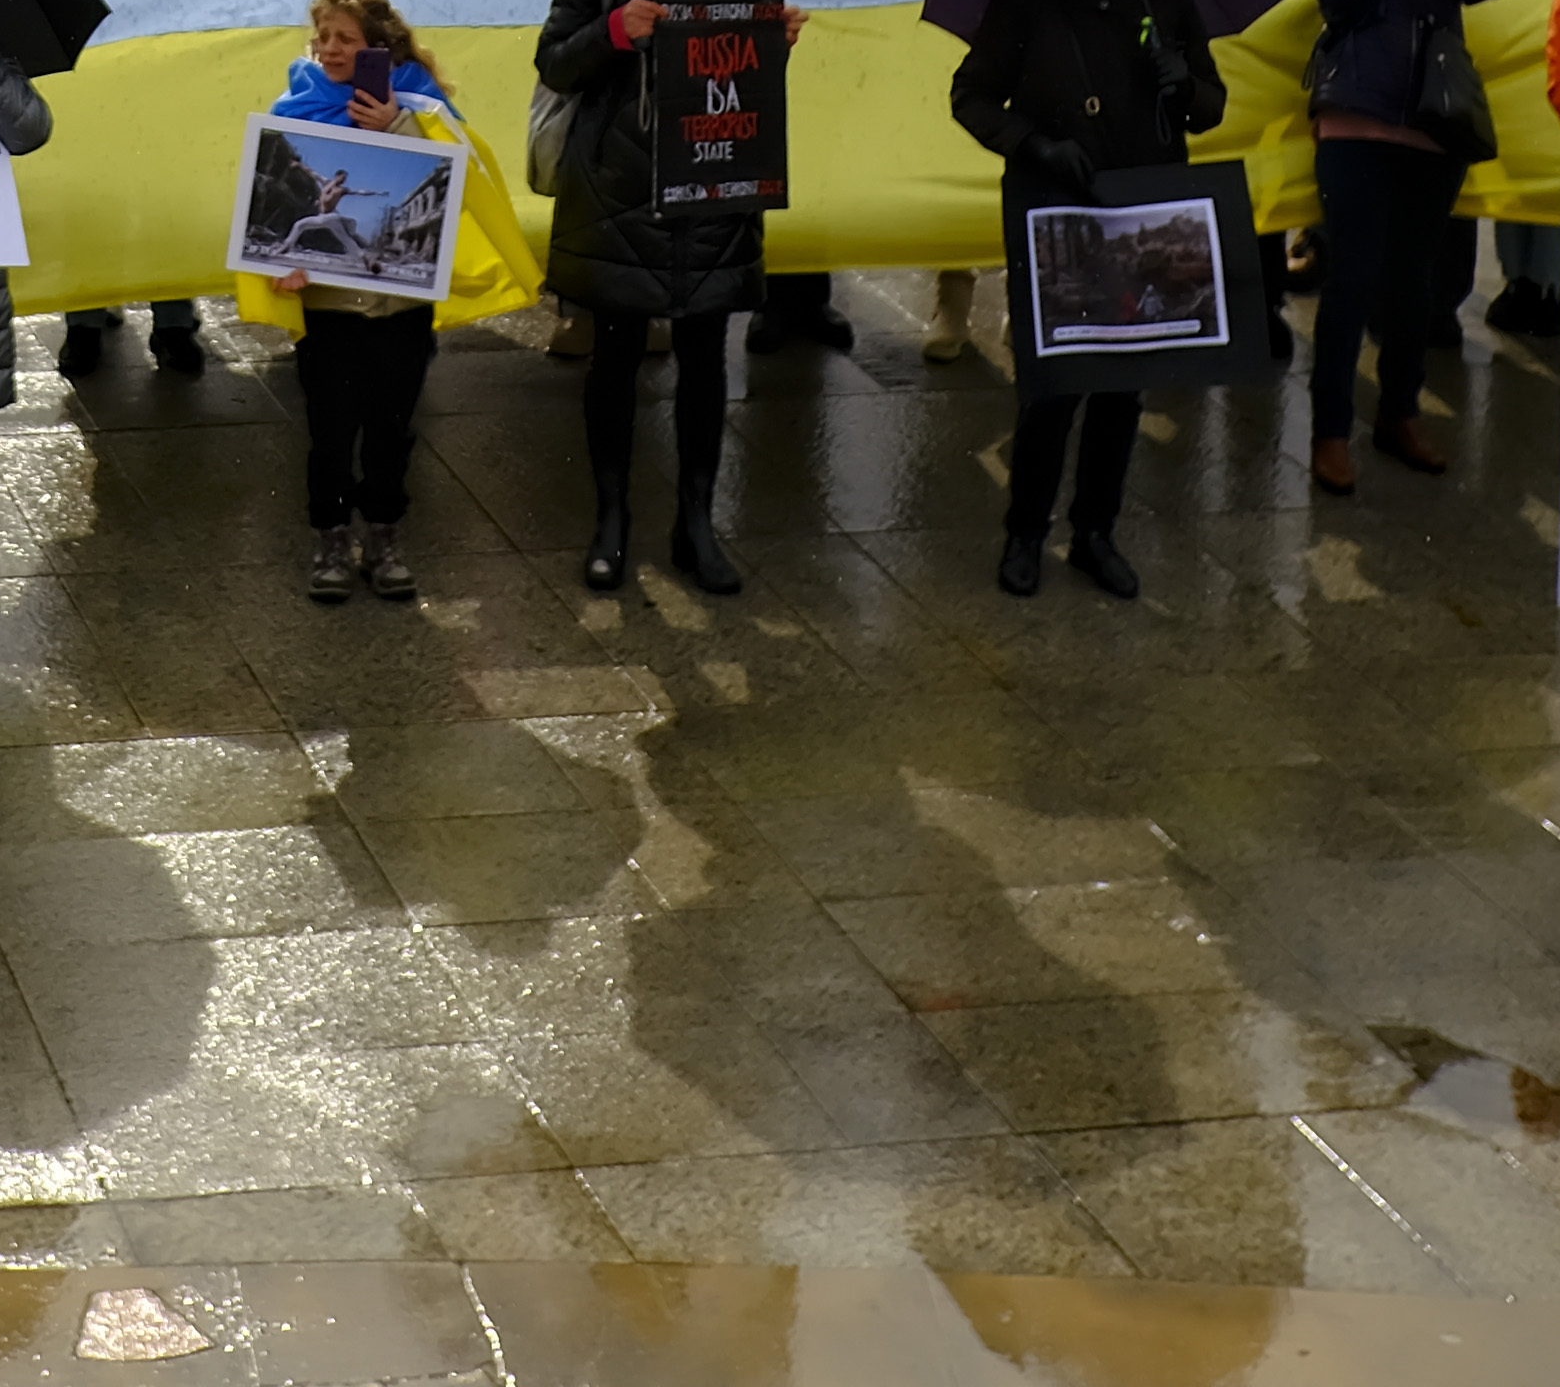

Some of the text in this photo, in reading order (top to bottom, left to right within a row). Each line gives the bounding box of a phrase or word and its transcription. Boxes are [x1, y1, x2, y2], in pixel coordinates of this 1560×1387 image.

[687, 33, 760, 77] RUSSIA
[682, 112, 759, 141] TERRORIST
[693, 141, 734, 163] STATE
